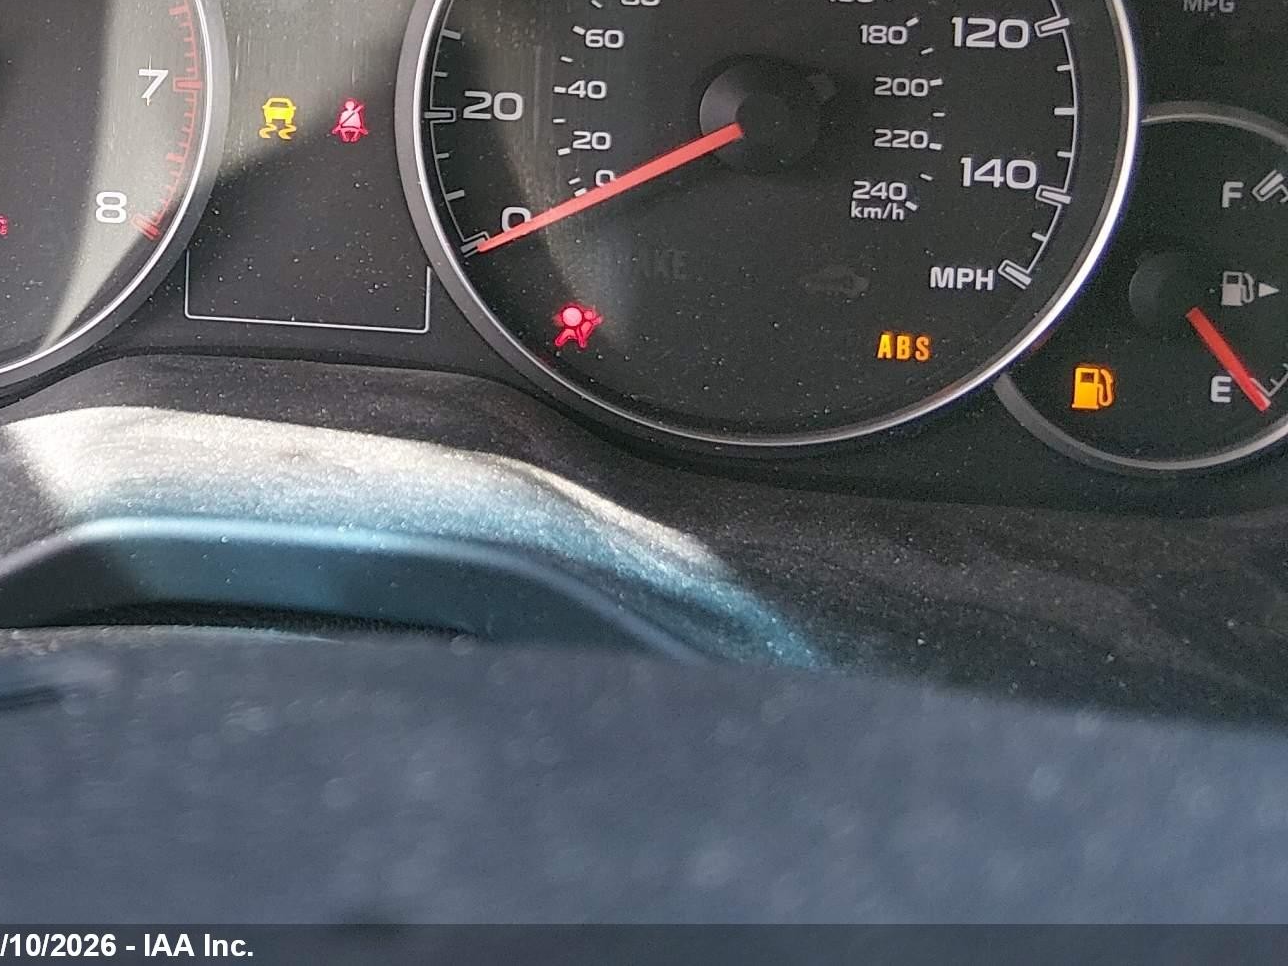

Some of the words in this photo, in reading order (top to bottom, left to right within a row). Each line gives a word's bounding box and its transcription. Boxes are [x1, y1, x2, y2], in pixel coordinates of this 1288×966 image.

[584, 29, 624, 49] 60
[860, 25, 908, 45] 180
[951, 17, 1029, 49] 120
[138, 68, 169, 100] 7
[567, 80, 607, 99] 40
[874, 77, 929, 97] 200
[463, 91, 523, 121] 20
[572, 131, 612, 150] 20
[873, 129, 929, 149] 220
[960, 157, 1037, 189] 140
[852, 181, 907, 201] 240
[1222, 181, 1245, 208] F
[95, 191, 128, 224] 8
[851, 201, 905, 221] km/h
[930, 267, 994, 291] MPH
[877, 334, 932, 361] ABS
[1210, 376, 1232, 403] E
